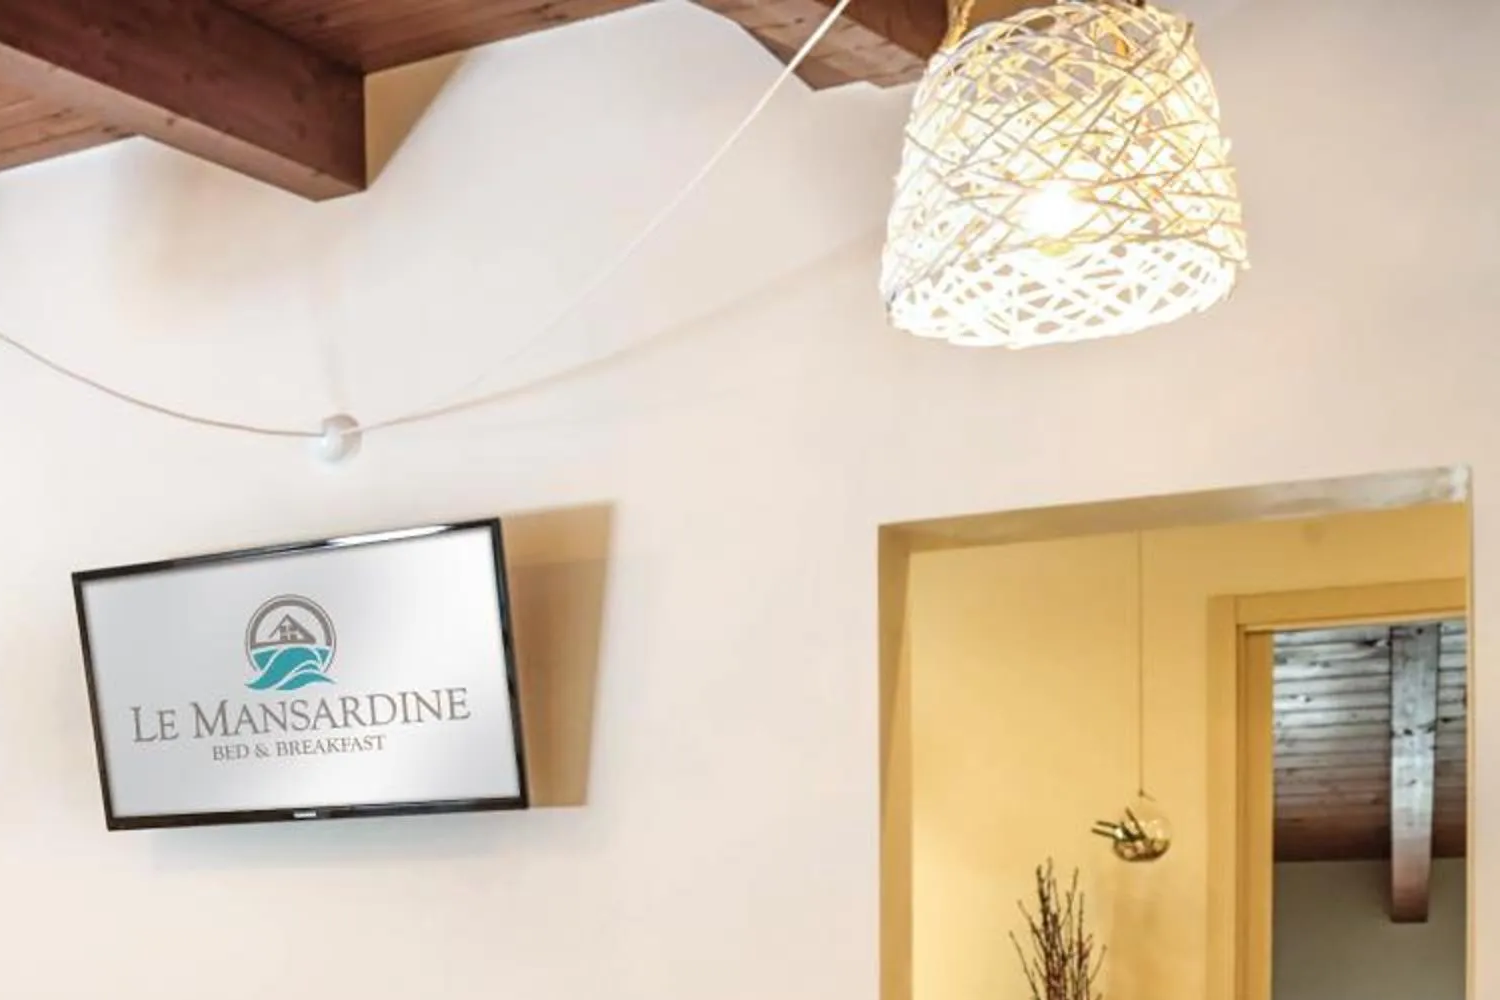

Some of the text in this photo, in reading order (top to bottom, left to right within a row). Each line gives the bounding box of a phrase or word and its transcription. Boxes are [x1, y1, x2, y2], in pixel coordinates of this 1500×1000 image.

[190, 686, 472, 739] MANSARDINE
[211, 734, 387, 761] BED & BREAKFAST
